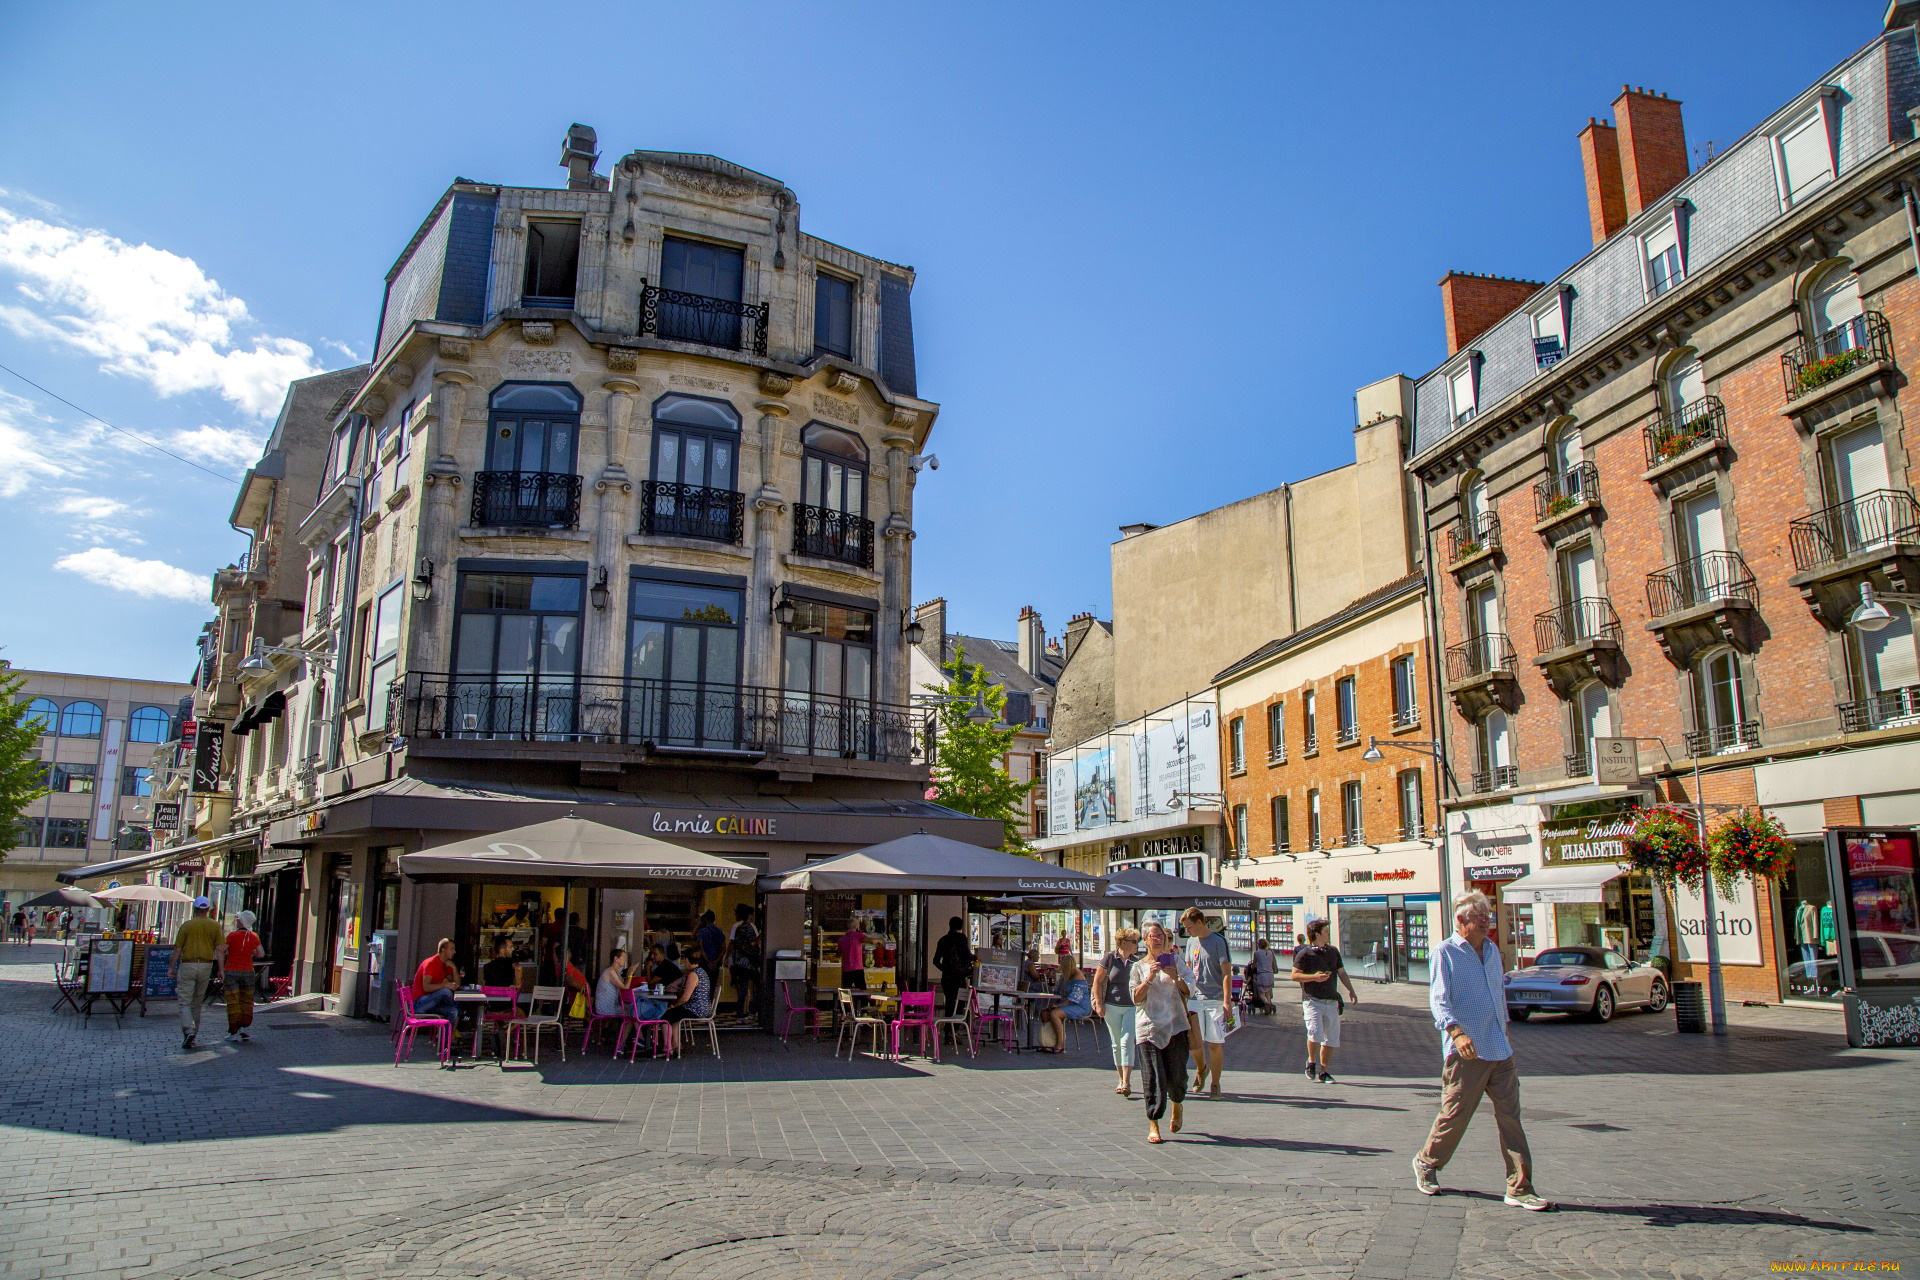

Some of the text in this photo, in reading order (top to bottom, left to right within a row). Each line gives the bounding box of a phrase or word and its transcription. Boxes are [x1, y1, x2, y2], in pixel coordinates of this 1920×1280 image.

[196, 736, 222, 790] Louise
[1601, 756, 1633, 764] INSTITUT
[158, 804, 177, 814] Jean
[156, 812, 178, 821] Louis
[155, 820, 177, 829] David
[652, 811, 777, 835] la mie CÂLINE
[1584, 820, 1638, 840] Institut
[1142, 835, 1200, 857] CINEMAS
[1561, 840, 1625, 860] ELISABETH
[649, 867, 664, 876] la
[665, 868, 693, 878] mie
[1373, 868, 1415, 882] immobilier
[1471, 867, 1491, 879] Cigarette
[1018, 878, 1032, 888] la
[1033, 880, 1058, 889] mie
[1194, 898, 1205, 907] la
[1205, 898, 1223, 907] mie
[1790, 983, 1828, 992] sandro
